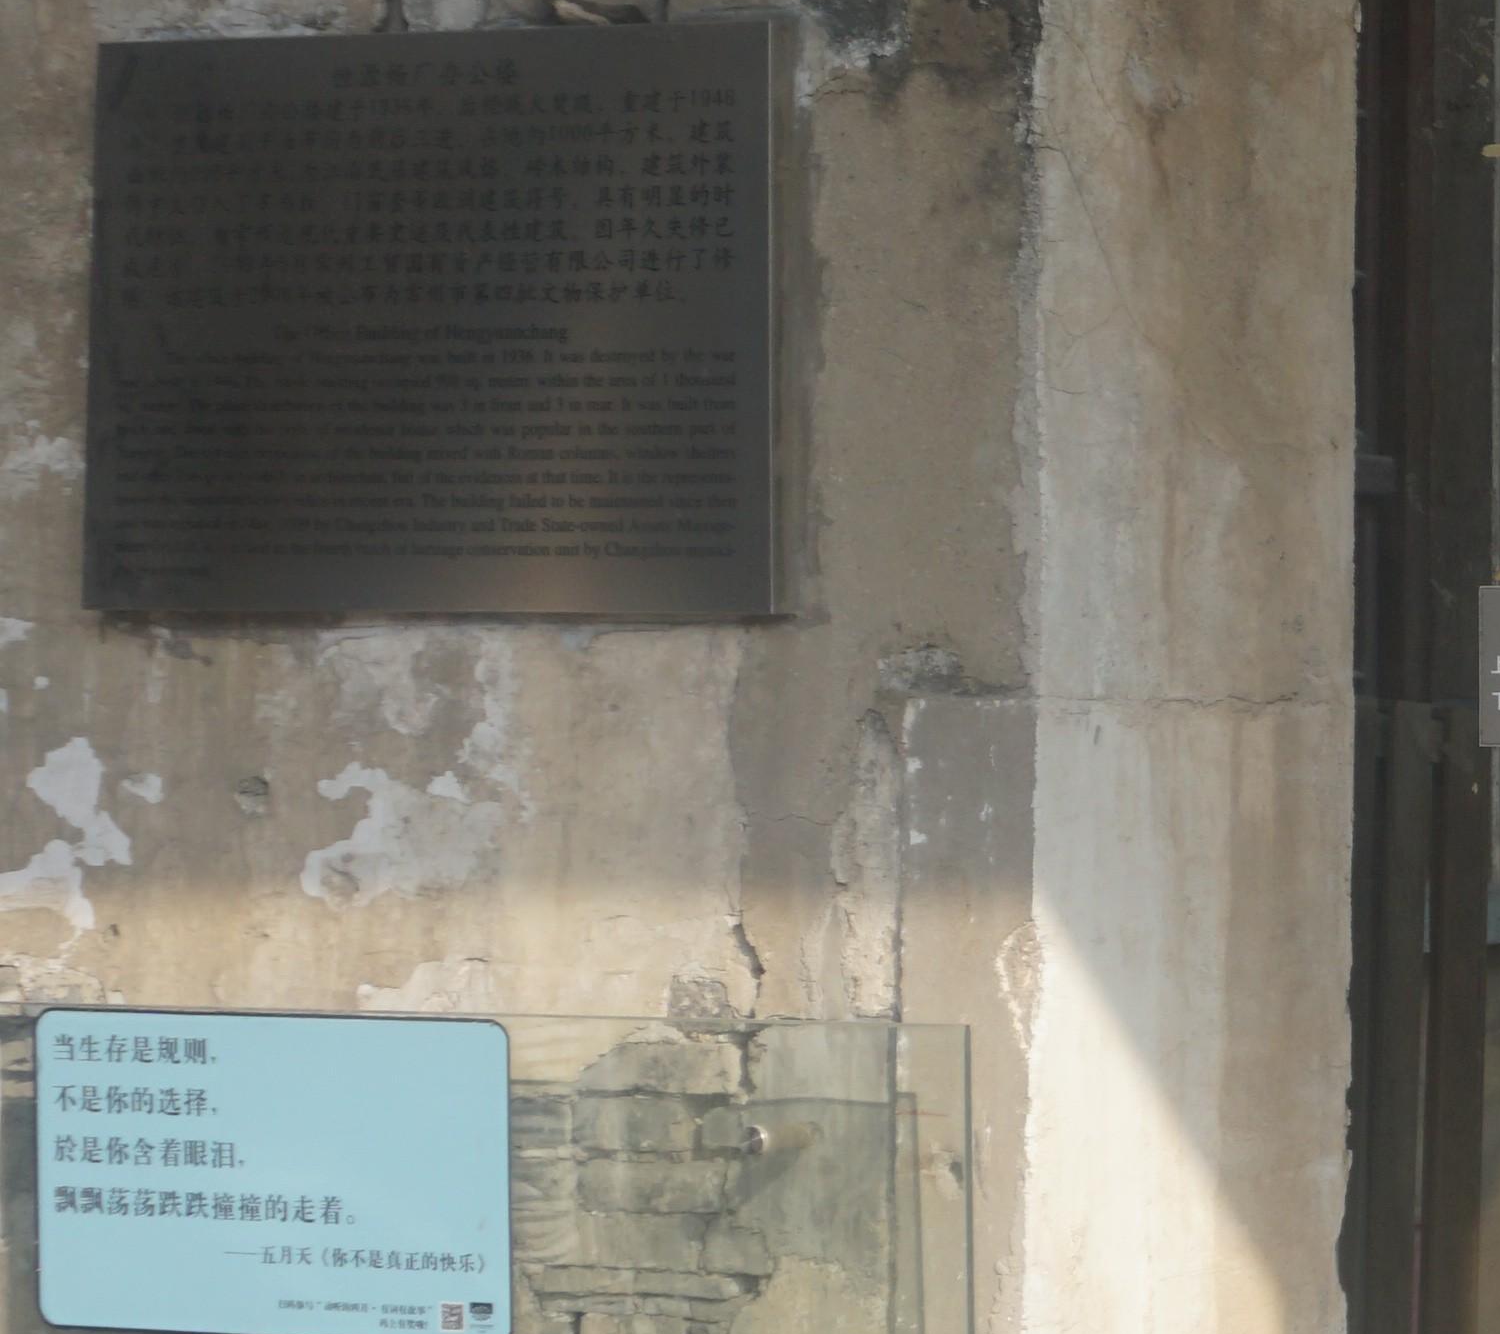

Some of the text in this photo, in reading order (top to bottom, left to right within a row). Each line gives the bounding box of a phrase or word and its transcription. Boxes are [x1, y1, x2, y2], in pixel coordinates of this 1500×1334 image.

[559, 353, 584, 363] was
[590, 348, 655, 365] destroyed
[661, 349, 679, 366] by
[684, 347, 704, 363] the
[711, 351, 736, 363] war
[537, 373, 579, 387] within
[583, 373, 604, 387] the
[609, 376, 637, 387] area
[642, 372, 656, 387] of
[675, 372, 736, 387] thousand
[491, 398, 521, 412] front
[527, 398, 550, 411] and
[638, 400, 661, 411] was
[667, 397, 698, 411] built
[704, 398, 736, 411] from
[490, 425, 515, 436] was
[522, 421, 572, 439] popular
[597, 421, 619, 435] the
[624, 421, 683, 436] southern
[689, 422, 715, 438] part
[721, 420, 736, 435] of
[474, 446, 501, 460] with
[507, 445, 553, 460] Roman
[625, 446, 679, 460] window
[436, 471, 454, 485] the
[542, 470, 567, 484] that
[637, 470, 658, 484] the
[421, 493, 446, 508] The
[451, 493, 504, 512] building
[551, 495, 564, 508] to
[568, 493, 584, 508] be
[413, 517, 465, 534] Industry
[471, 519, 494, 532] and
[501, 518, 537, 532] Trade
[542, 517, 624, 533] State-owned
[628, 518, 671, 532] Assets
[467, 543, 550, 557] conservation
[584, 542, 601, 559] by
[604, 541, 681, 560] Changzhou
[53, 1034, 217, 1065] 当生存是规则，
[53, 1084, 218, 1117] 不是你的选择，
[53, 1134, 246, 1169] 於是你含着眼泪，
[53, 1185, 356, 1226] 飘飘荡荡跌跌撞撞的走着。
